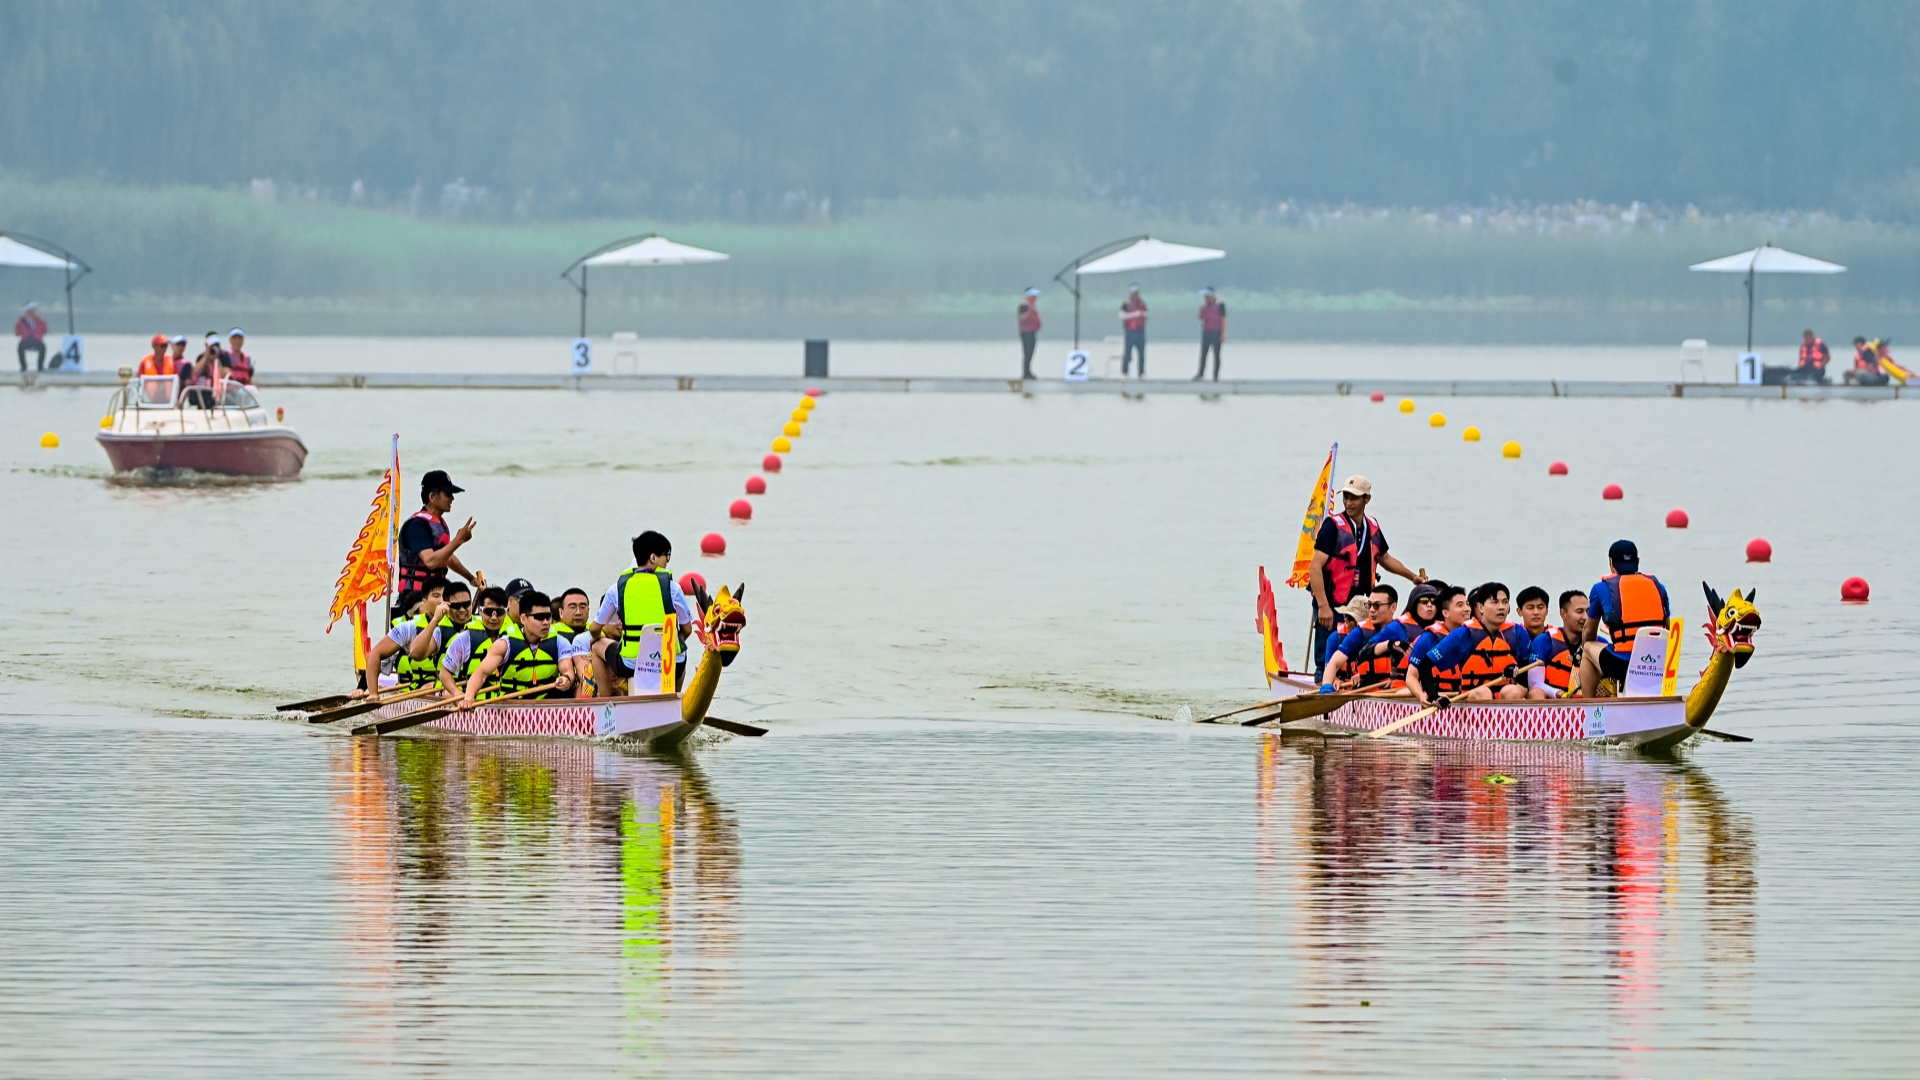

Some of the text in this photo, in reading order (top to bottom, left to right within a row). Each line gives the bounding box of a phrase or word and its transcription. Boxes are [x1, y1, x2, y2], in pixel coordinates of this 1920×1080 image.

[66, 339, 80, 364] 4
[576, 343, 589, 367] 3
[1069, 354, 1086, 376] 2
[1743, 355, 1755, 380] 1
[663, 617, 673, 675] 3
[1665, 621, 1680, 678] 2
